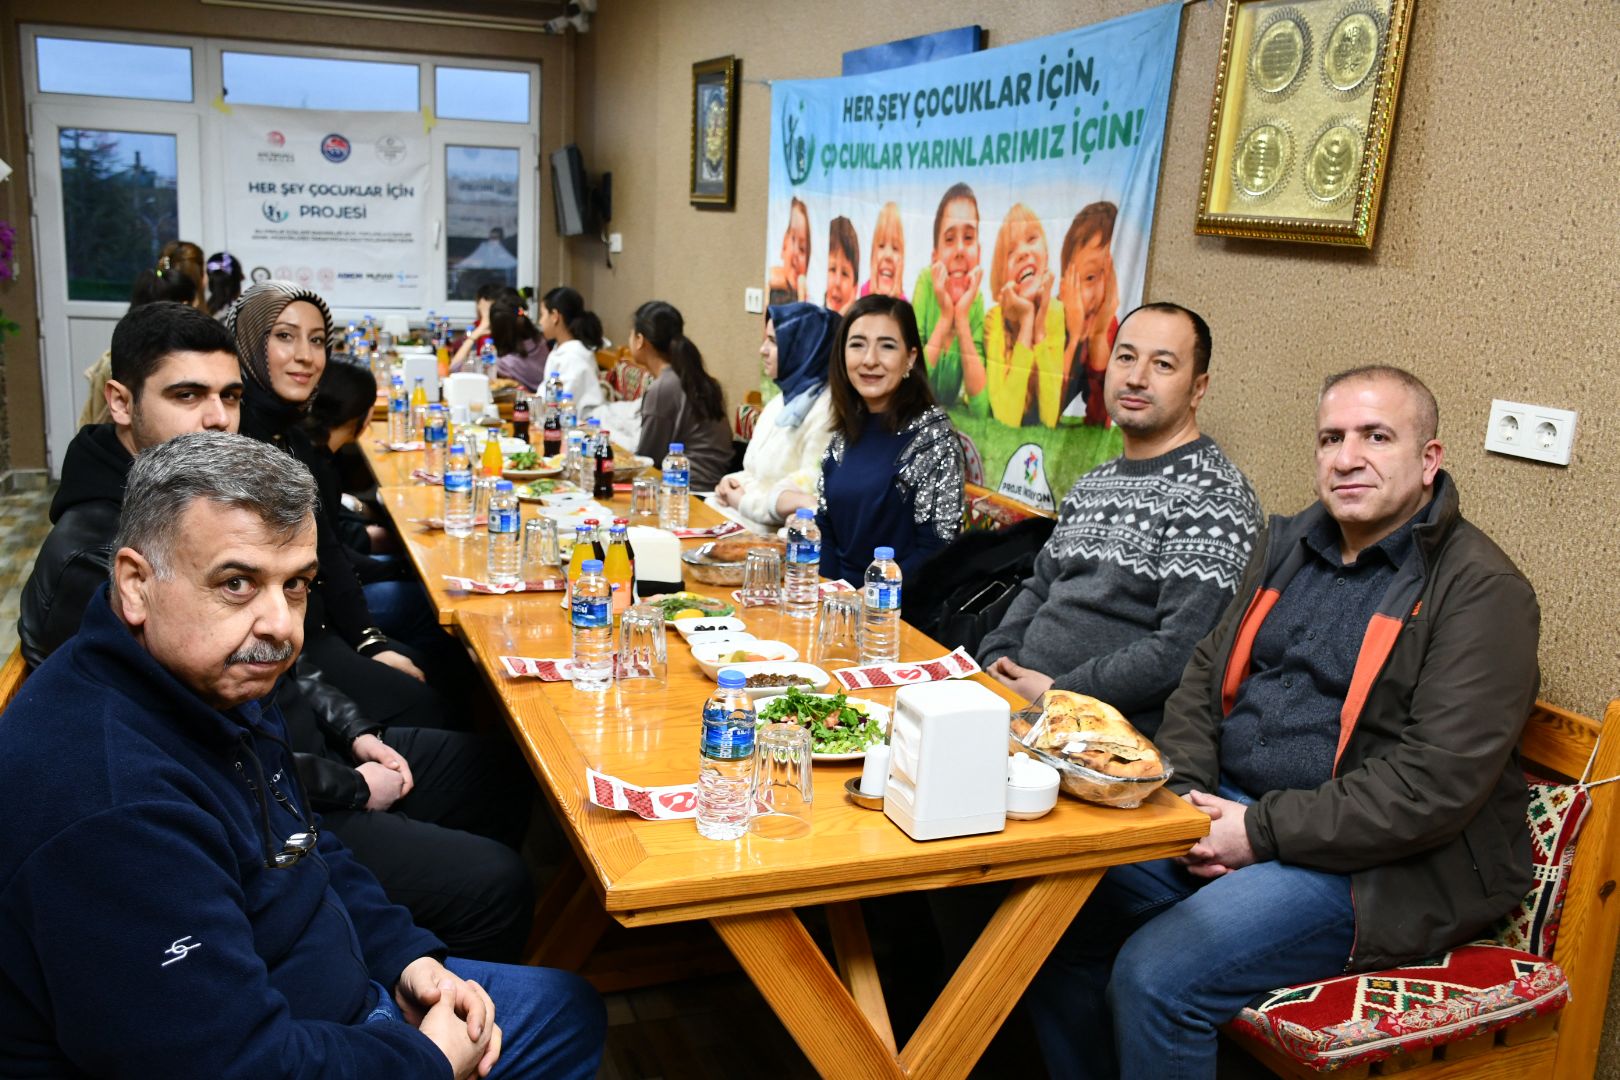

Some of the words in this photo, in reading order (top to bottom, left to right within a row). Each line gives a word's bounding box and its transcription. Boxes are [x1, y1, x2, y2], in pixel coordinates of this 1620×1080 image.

[842, 95, 874, 123] HER
[876, 91, 911, 131] ŞEY
[913, 72, 1032, 128] ÇOCUKLAR
[1037, 48, 1100, 111] İÇİN,
[820, 142, 903, 177] ÇOCUKLAR
[907, 123, 1066, 170] YARINLARIMIZ
[1071, 100, 1145, 165] İÇİN!
[248, 181, 277, 195] HER
[281, 182, 305, 197] ŞEY
[308, 183, 383, 198] ÇOCUKLAR
[386, 182, 414, 200] İÇİN
[299, 204, 367, 220] PROJESİ
